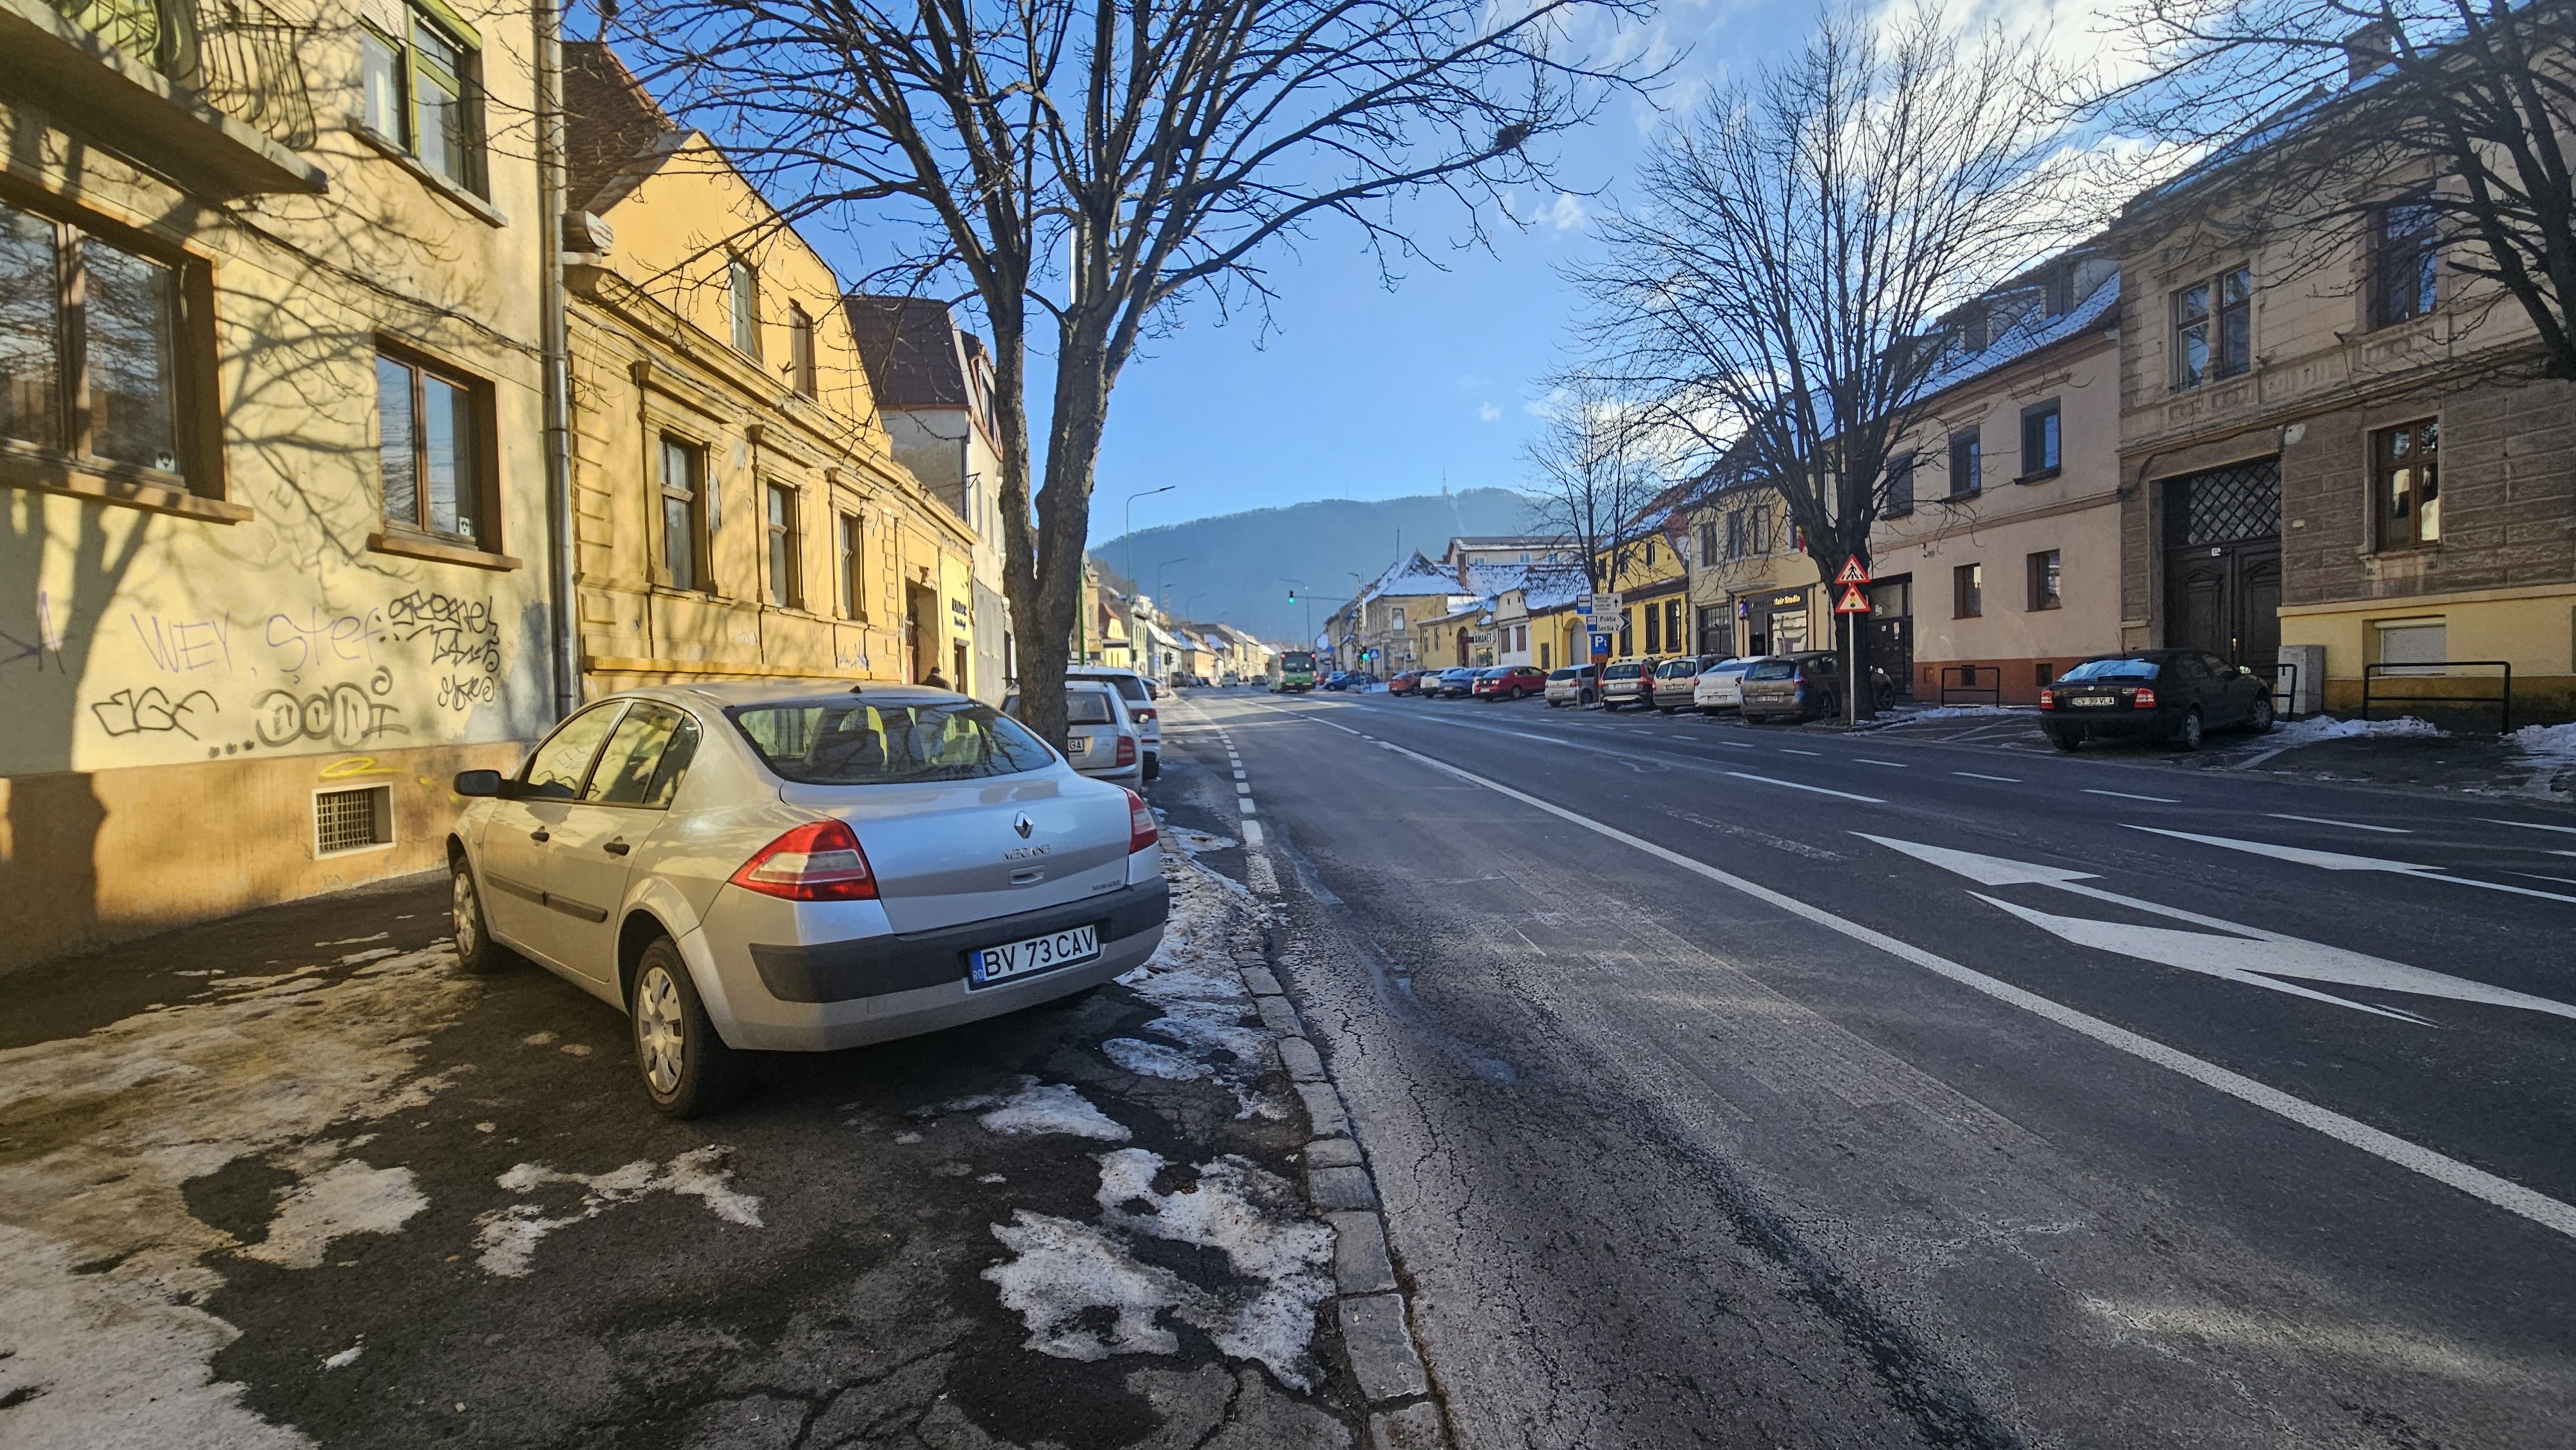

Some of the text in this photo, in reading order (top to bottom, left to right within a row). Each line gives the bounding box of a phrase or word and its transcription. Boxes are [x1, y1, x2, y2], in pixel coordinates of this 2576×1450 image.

[1004, 844, 1050, 861] MEGANE
[983, 946, 1016, 977] BV
[1025, 939, 1052, 967] 73
[1056, 927, 1094, 957] CAV
